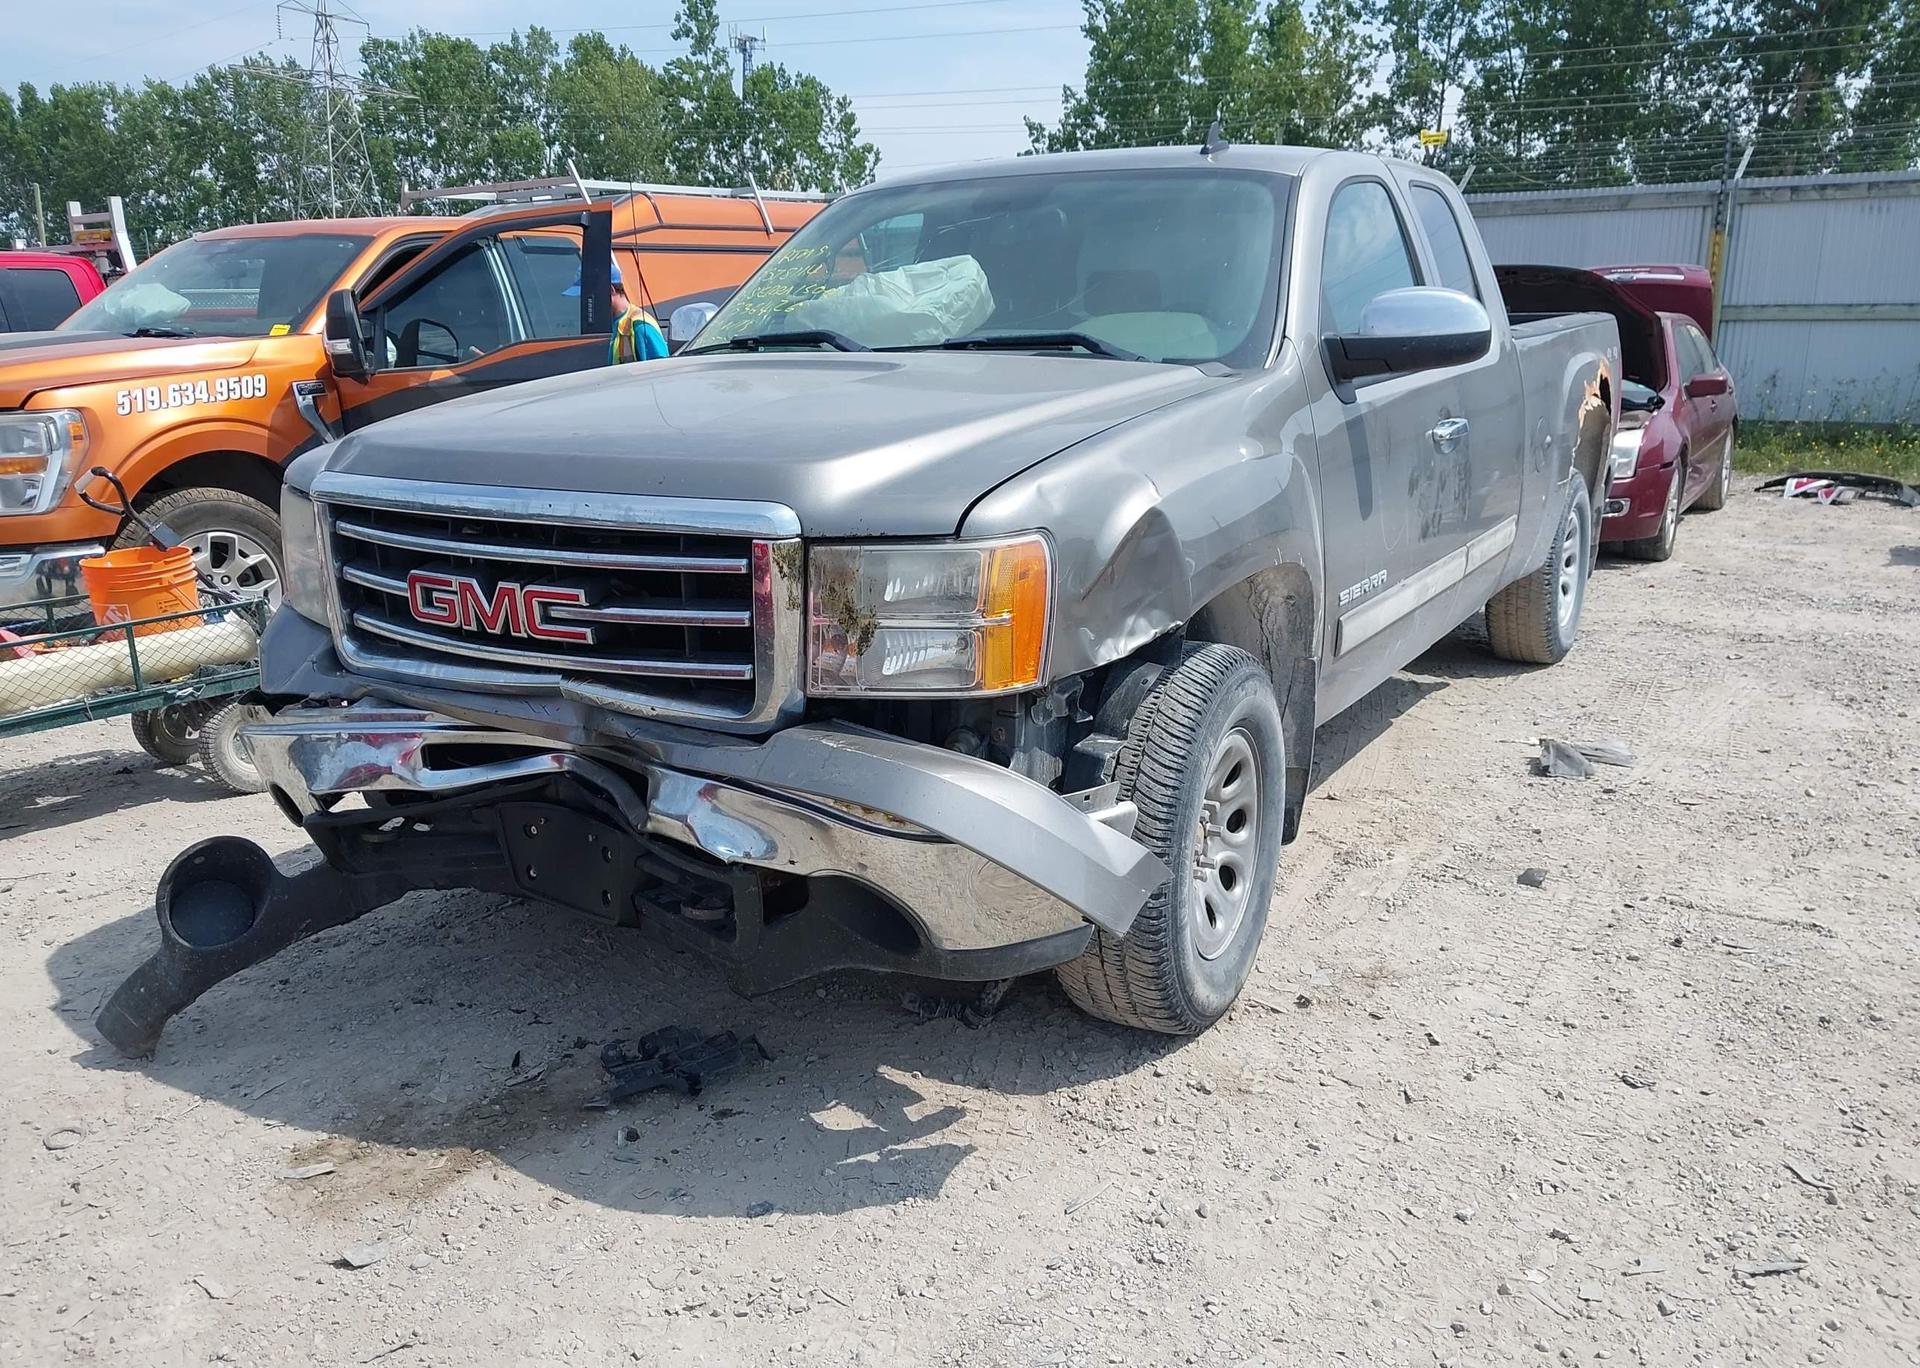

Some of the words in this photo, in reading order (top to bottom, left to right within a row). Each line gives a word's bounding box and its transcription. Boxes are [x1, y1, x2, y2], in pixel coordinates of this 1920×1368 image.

[117, 374, 267, 416] 519.634.9509
[407, 570, 593, 645] GMC
[1339, 569, 1387, 606] SIERRA
